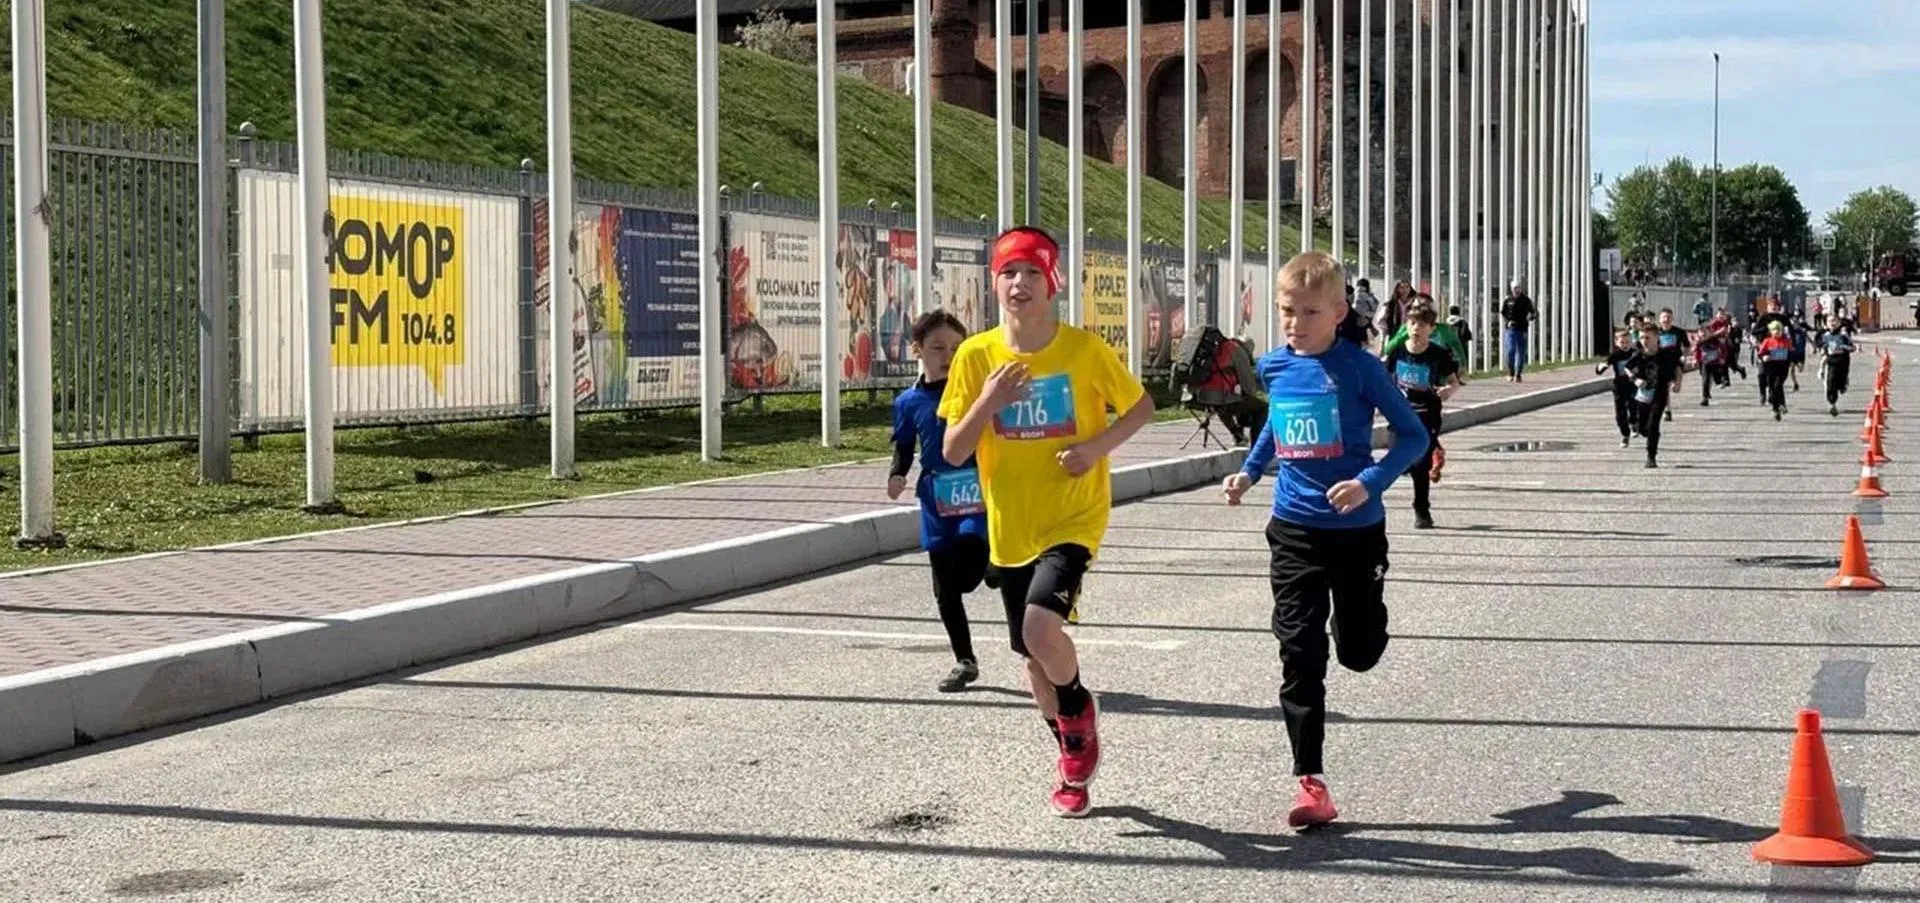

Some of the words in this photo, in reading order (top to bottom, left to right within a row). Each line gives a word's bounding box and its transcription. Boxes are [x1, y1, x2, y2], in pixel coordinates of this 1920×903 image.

[329, 219, 455, 299] ЮМОР
[756, 278, 799, 297] KOLOMNA
[800, 279, 821, 297] TAST
[329, 288, 389, 345] FM
[401, 314, 455, 345] 104.8
[1011, 399, 1048, 427] 716
[1284, 418, 1319, 445] 620
[951, 483, 981, 506] 642
